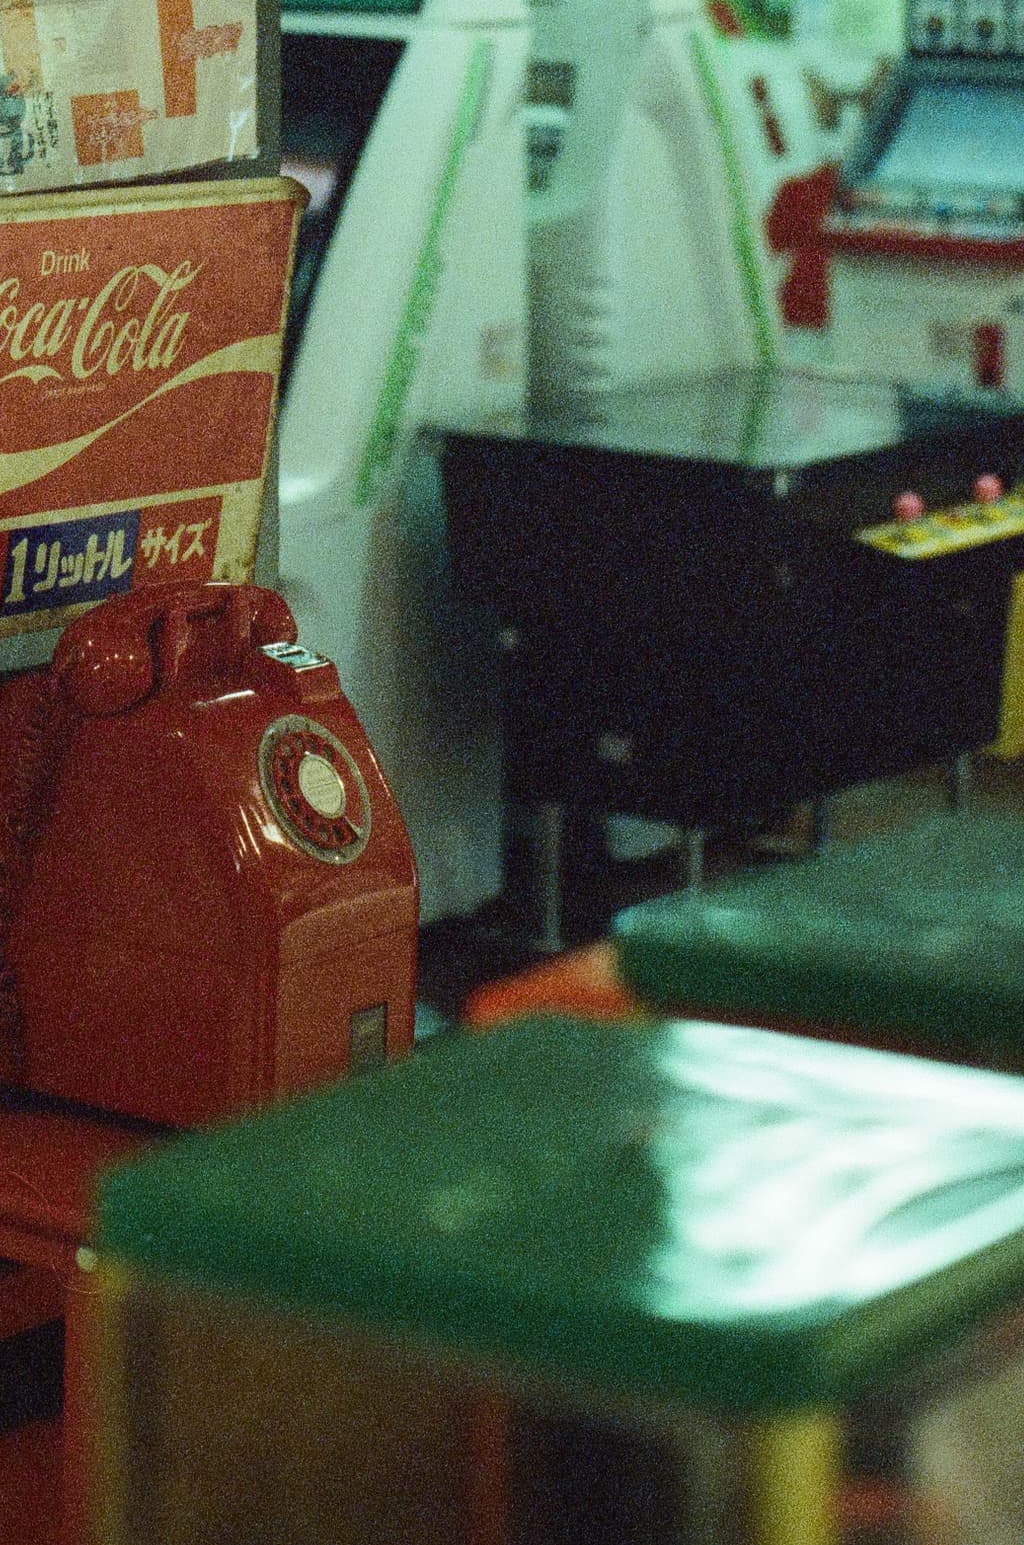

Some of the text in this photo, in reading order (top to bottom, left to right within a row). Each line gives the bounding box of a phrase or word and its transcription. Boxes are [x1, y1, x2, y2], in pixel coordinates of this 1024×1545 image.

[41, 248, 90, 276] Drink
[141, 518, 214, 569] サイズ
